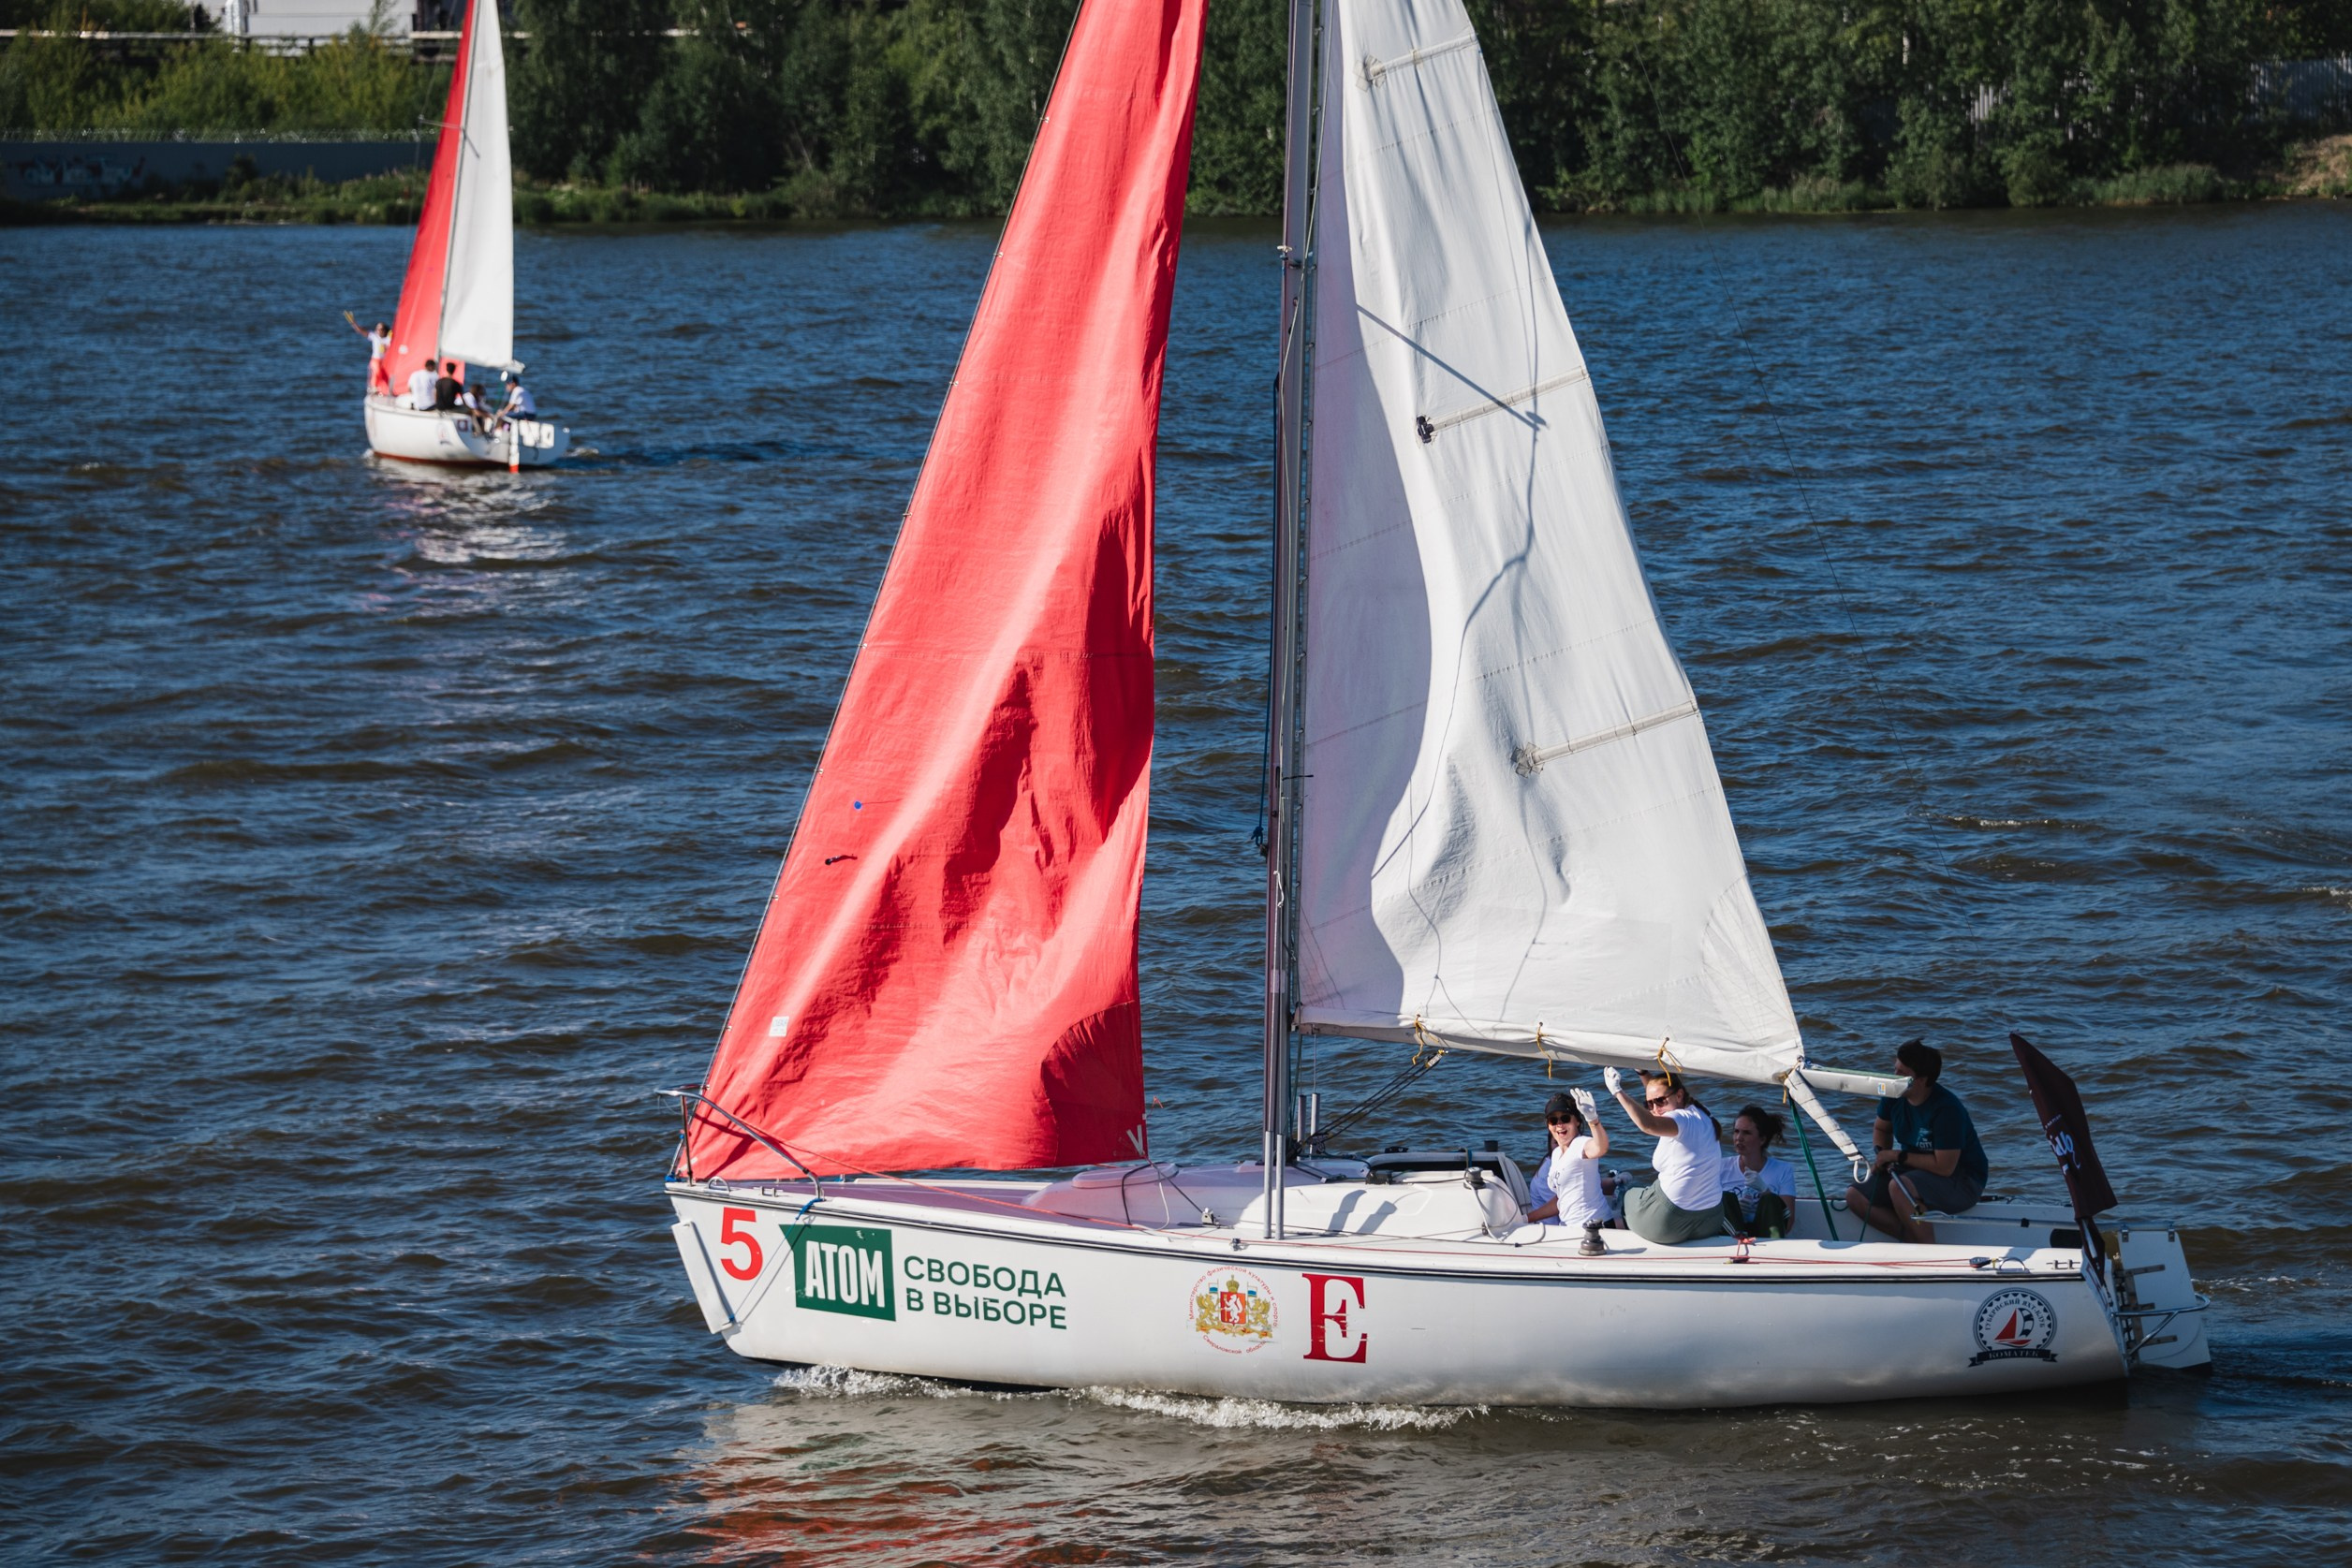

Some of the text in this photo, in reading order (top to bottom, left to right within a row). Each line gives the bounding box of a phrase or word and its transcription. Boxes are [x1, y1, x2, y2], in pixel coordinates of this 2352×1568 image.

[721, 1207, 764, 1281] 5
[805, 1240, 885, 1308] АТОМ
[904, 1255, 1066, 1298] СВОБОДА
[1189, 1275, 1206, 1320] Министерство
[1207, 1266, 1247, 1276] физической
[1248, 1270, 1272, 1296] культуры
[905, 1288, 1066, 1329] В ВЫБОРЕ
[1985, 1297, 2045, 1330] ГУБЕРНСКИЙ ЯХТ-КЛУБ
[1203, 1335, 1242, 1354] Свердловской
[1989, 1350, 2038, 1359] КОМАТЕК
